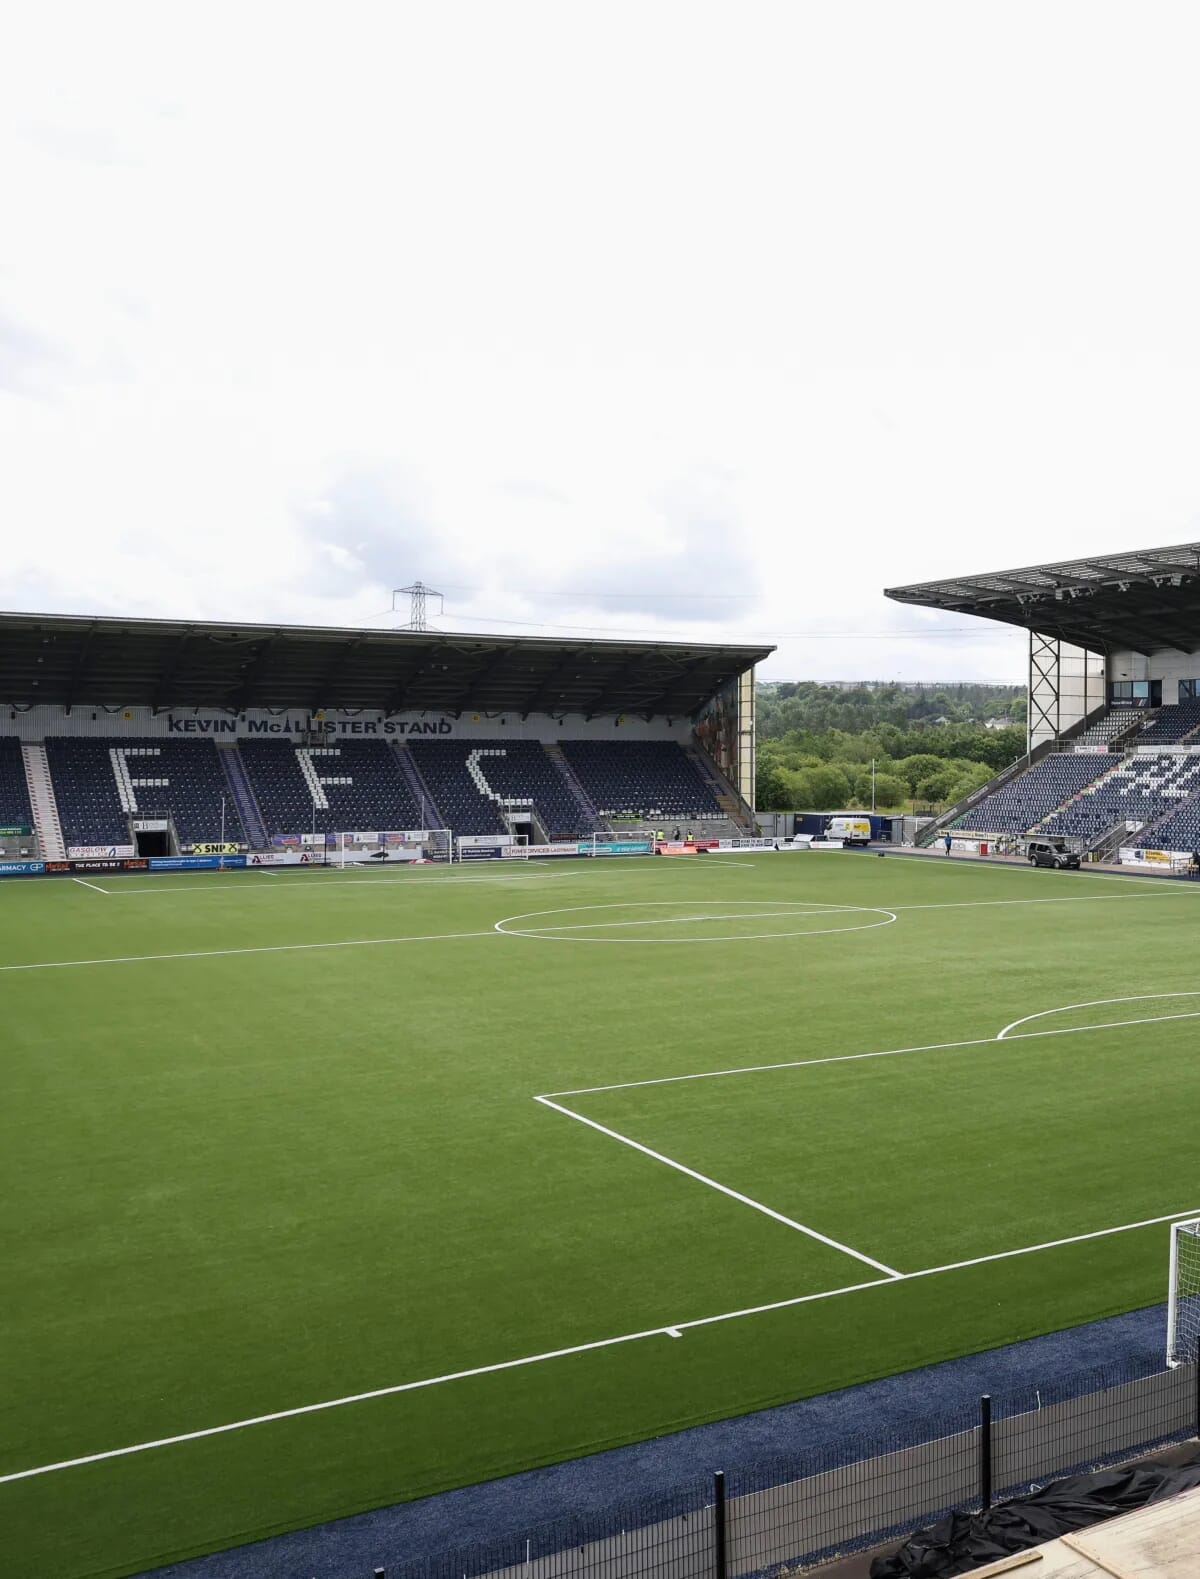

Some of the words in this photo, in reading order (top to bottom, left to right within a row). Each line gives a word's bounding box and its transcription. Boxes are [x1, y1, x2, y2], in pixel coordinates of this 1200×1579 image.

[168, 719, 237, 733] KEVIN
[383, 720, 453, 734] STAND
[204, 844, 226, 853] SNP
